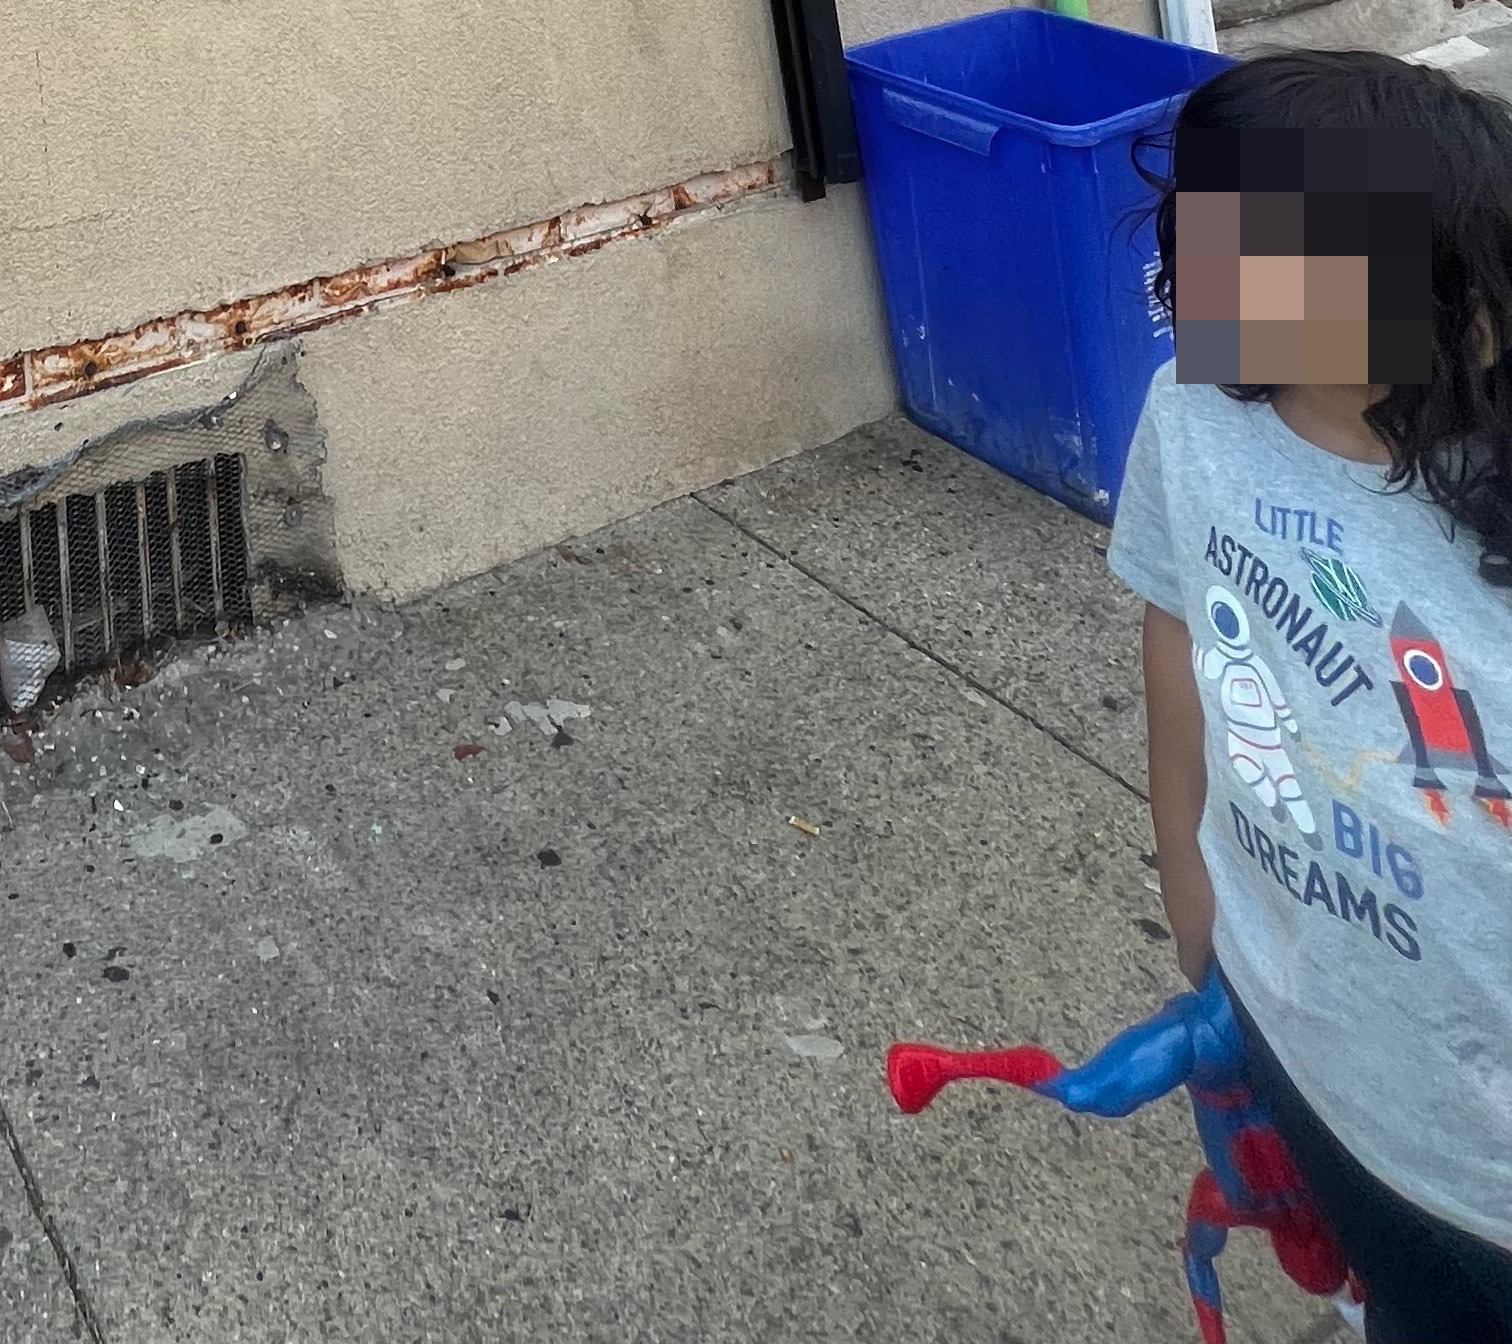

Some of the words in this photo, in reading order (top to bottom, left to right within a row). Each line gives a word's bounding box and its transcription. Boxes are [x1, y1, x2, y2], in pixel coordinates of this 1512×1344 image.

[1254, 497, 1344, 556] LITTLE
[1205, 525, 1374, 708] ASTRONAUT
[1229, 800, 1423, 962] DREAMS
[1333, 800, 1425, 900] BIG
